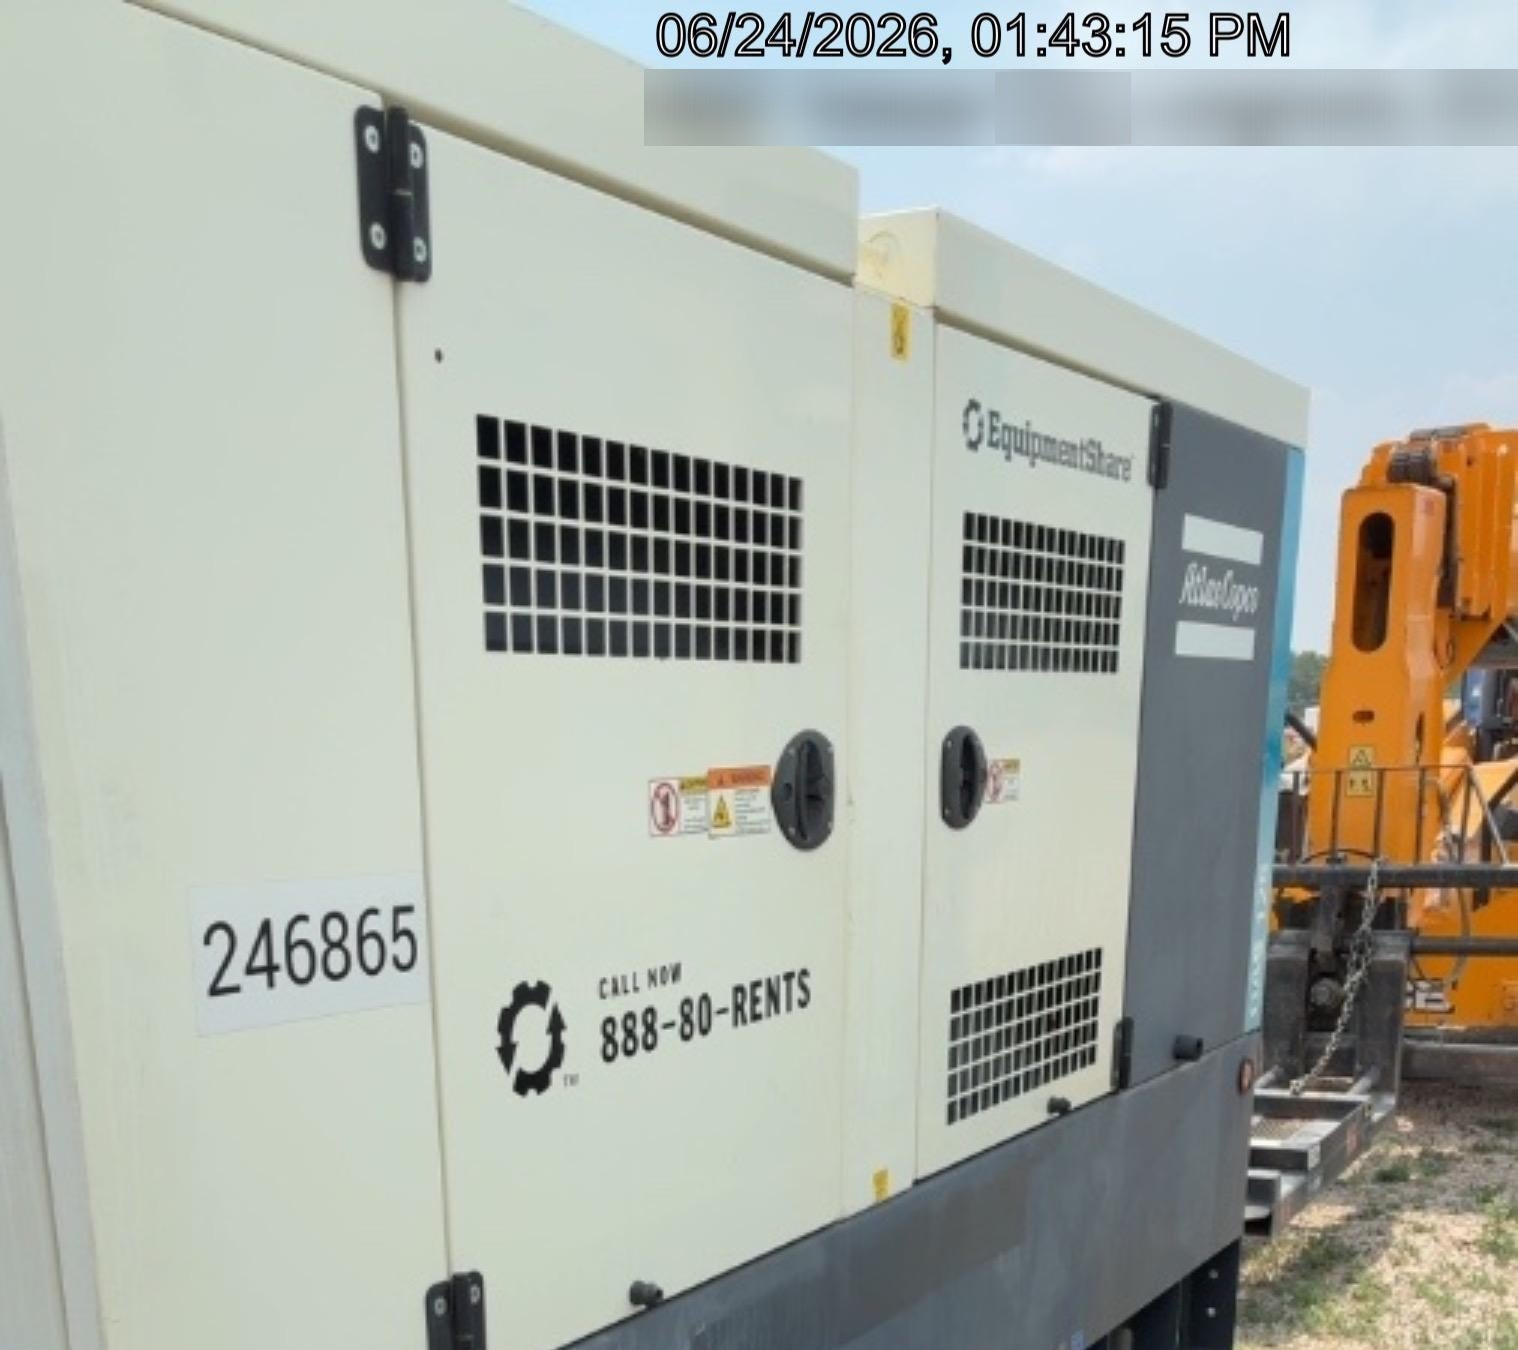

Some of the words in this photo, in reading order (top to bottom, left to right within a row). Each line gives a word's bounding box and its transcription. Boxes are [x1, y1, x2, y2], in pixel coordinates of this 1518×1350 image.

[986, 409, 1132, 482] EquipmentShare
[203, 904, 418, 997] 246865
[599, 973, 640, 1000] CALL
[647, 962, 683, 989] NOW
[600, 968, 812, 1063] 888-80-RENTS
